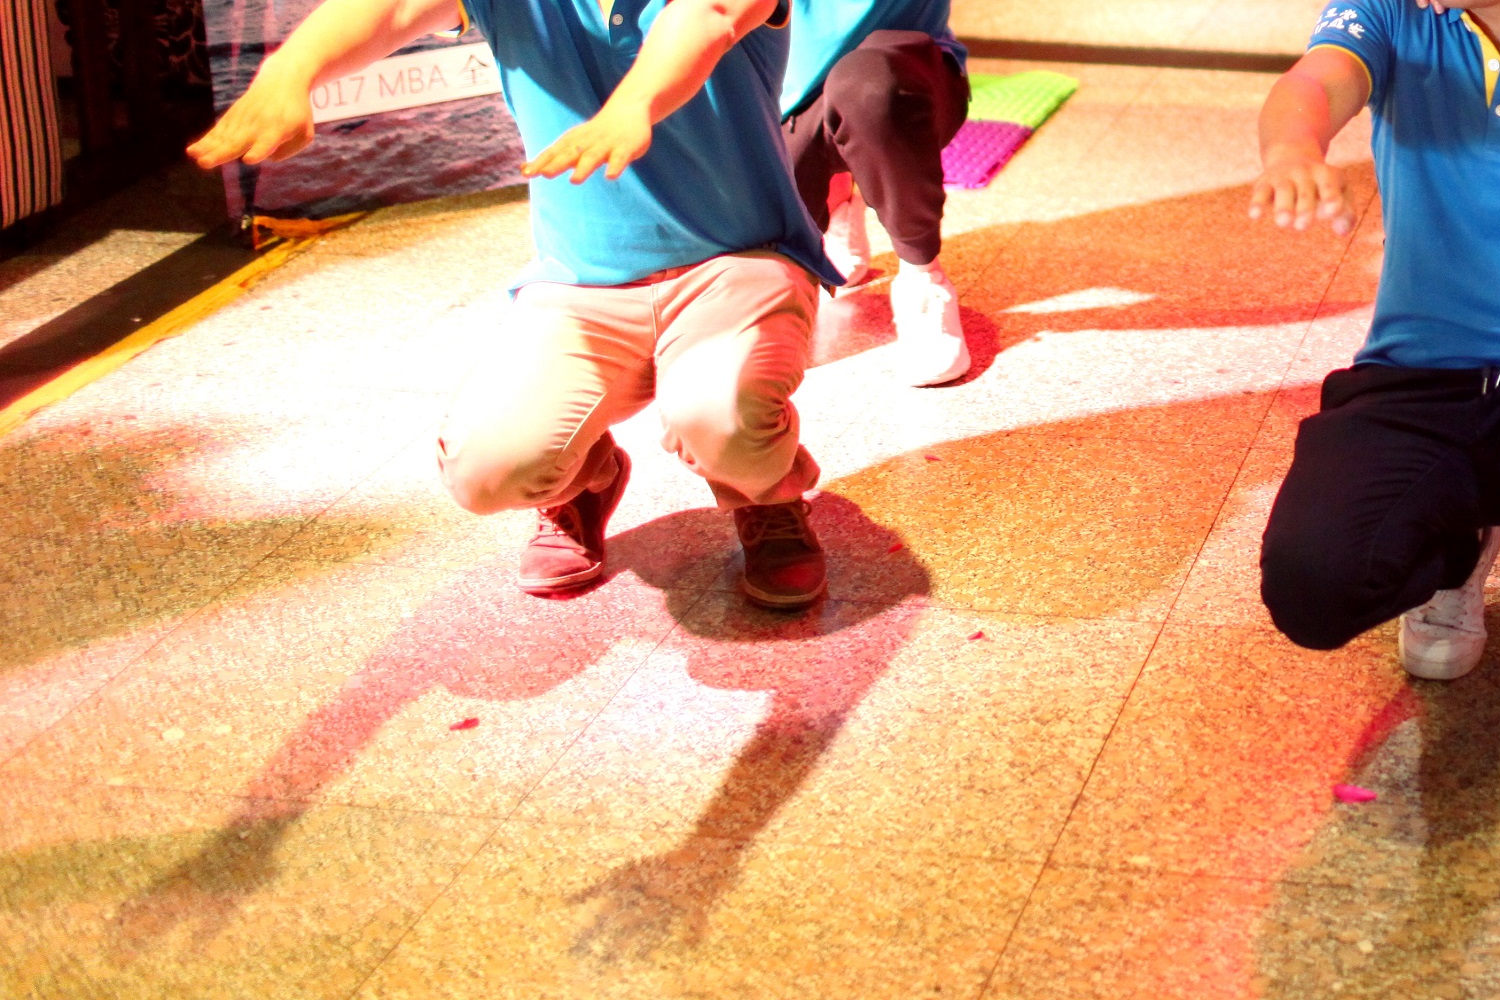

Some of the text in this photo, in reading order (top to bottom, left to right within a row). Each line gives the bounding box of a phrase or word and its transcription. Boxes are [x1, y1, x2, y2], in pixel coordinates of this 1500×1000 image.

[312, 53, 491, 109] 017 MBA 全
